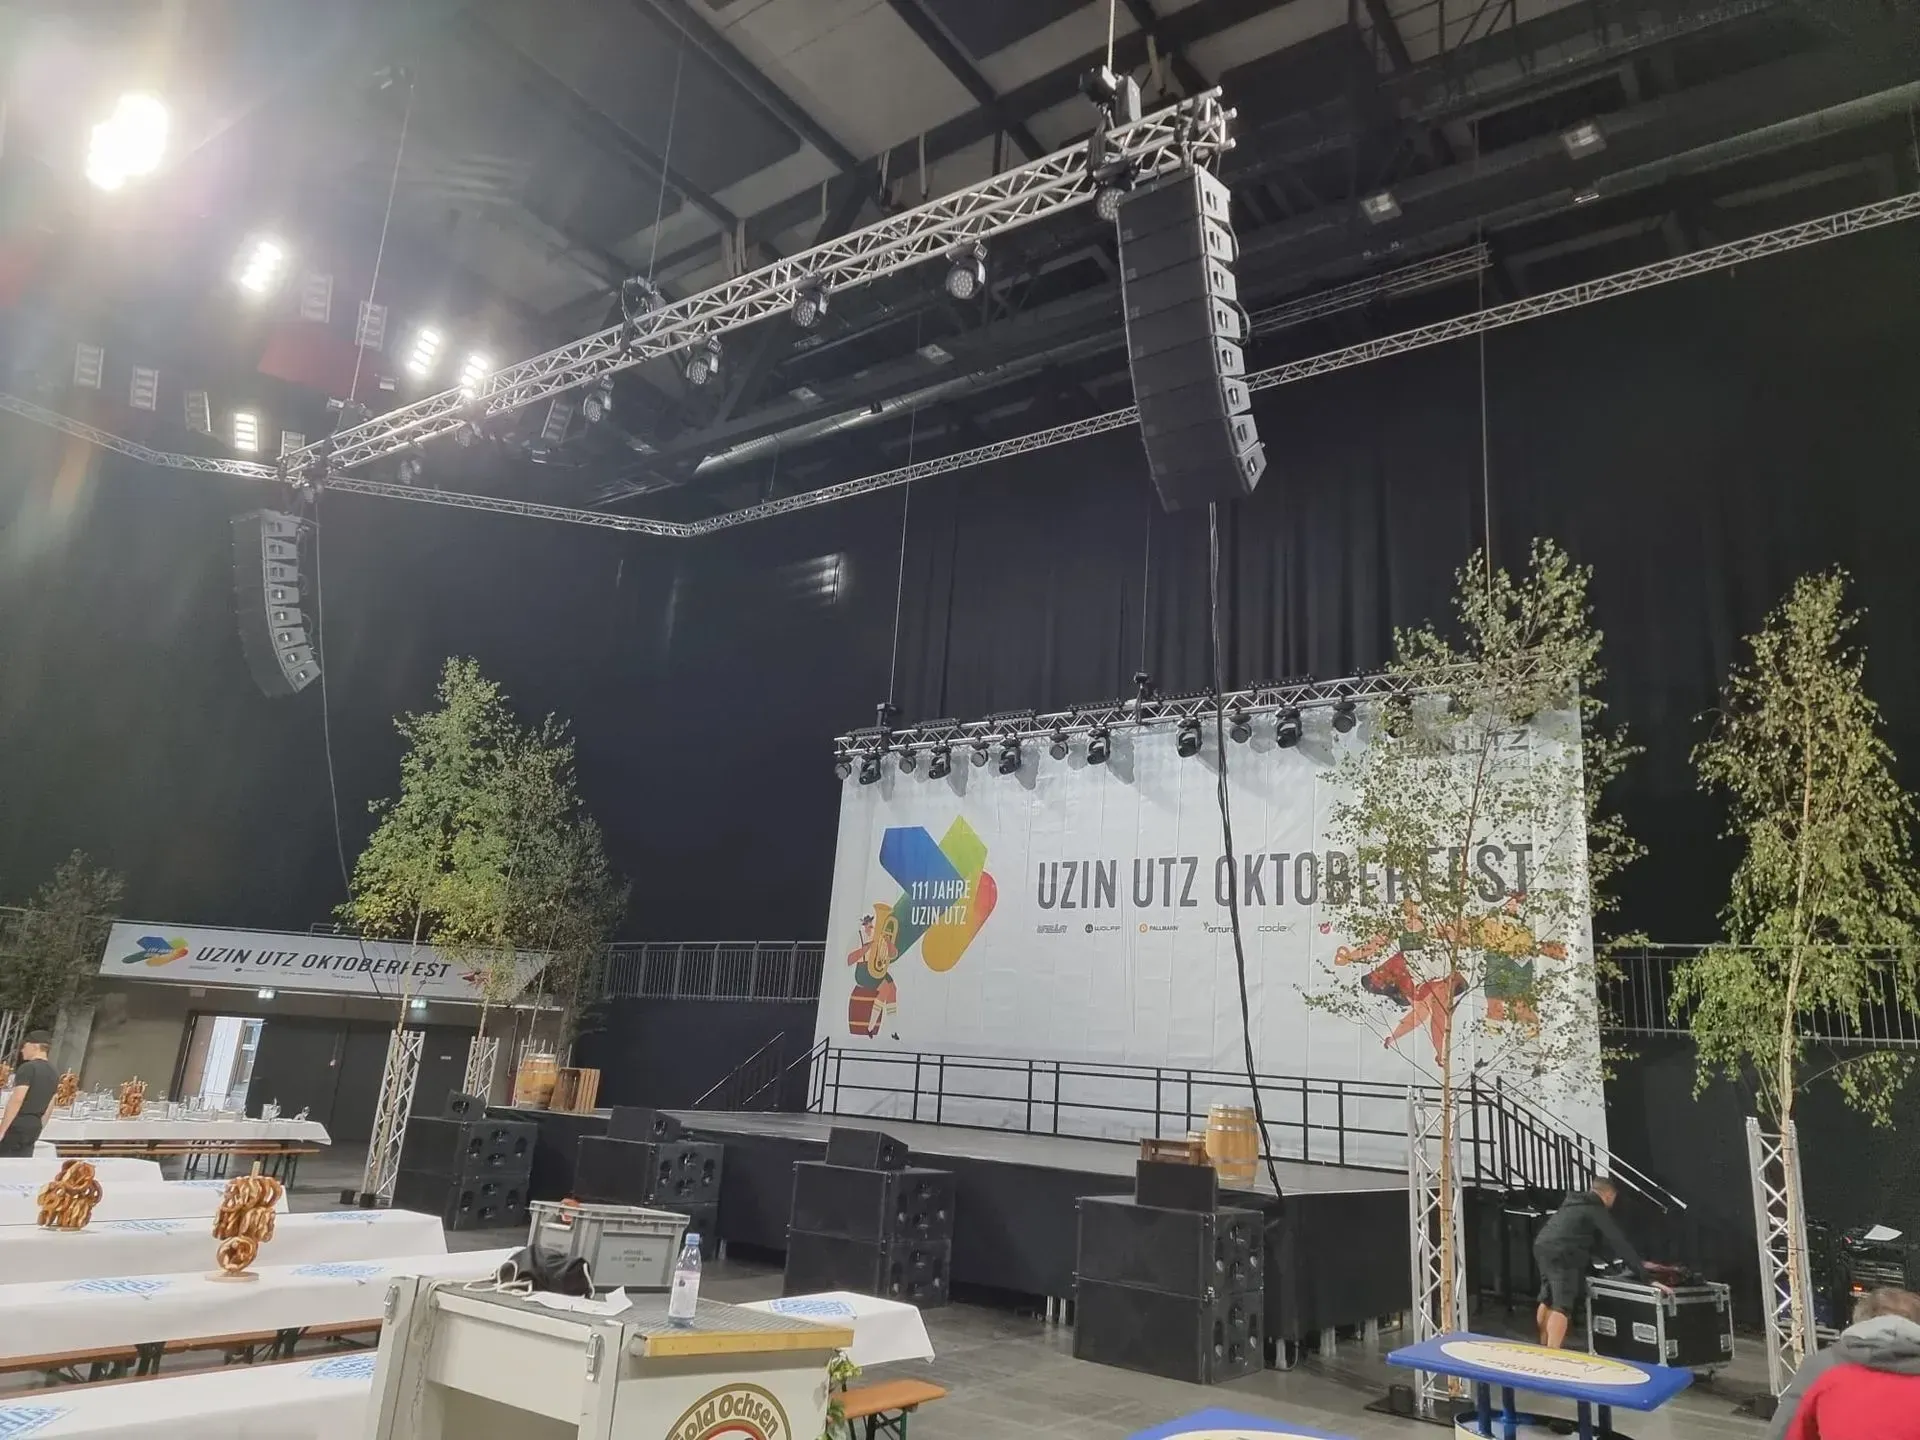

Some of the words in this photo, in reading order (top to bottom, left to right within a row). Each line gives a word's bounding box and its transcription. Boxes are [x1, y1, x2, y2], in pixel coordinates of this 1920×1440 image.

[911, 880, 929, 900] 111
[932, 879, 971, 900] JAHRE
[1037, 859, 1117, 910] UZIN
[1133, 856, 1199, 908] UTZ
[911, 905, 941, 926] UZIN
[944, 904, 967, 926] UTZ
[1149, 924, 1179, 932] PALLMANN
[196, 946, 253, 965] UZIN
[255, 949, 299, 968] UTZ
[301, 953, 451, 979] OKTOBERFEST
[718, 1392, 779, 1439] Ochsen
